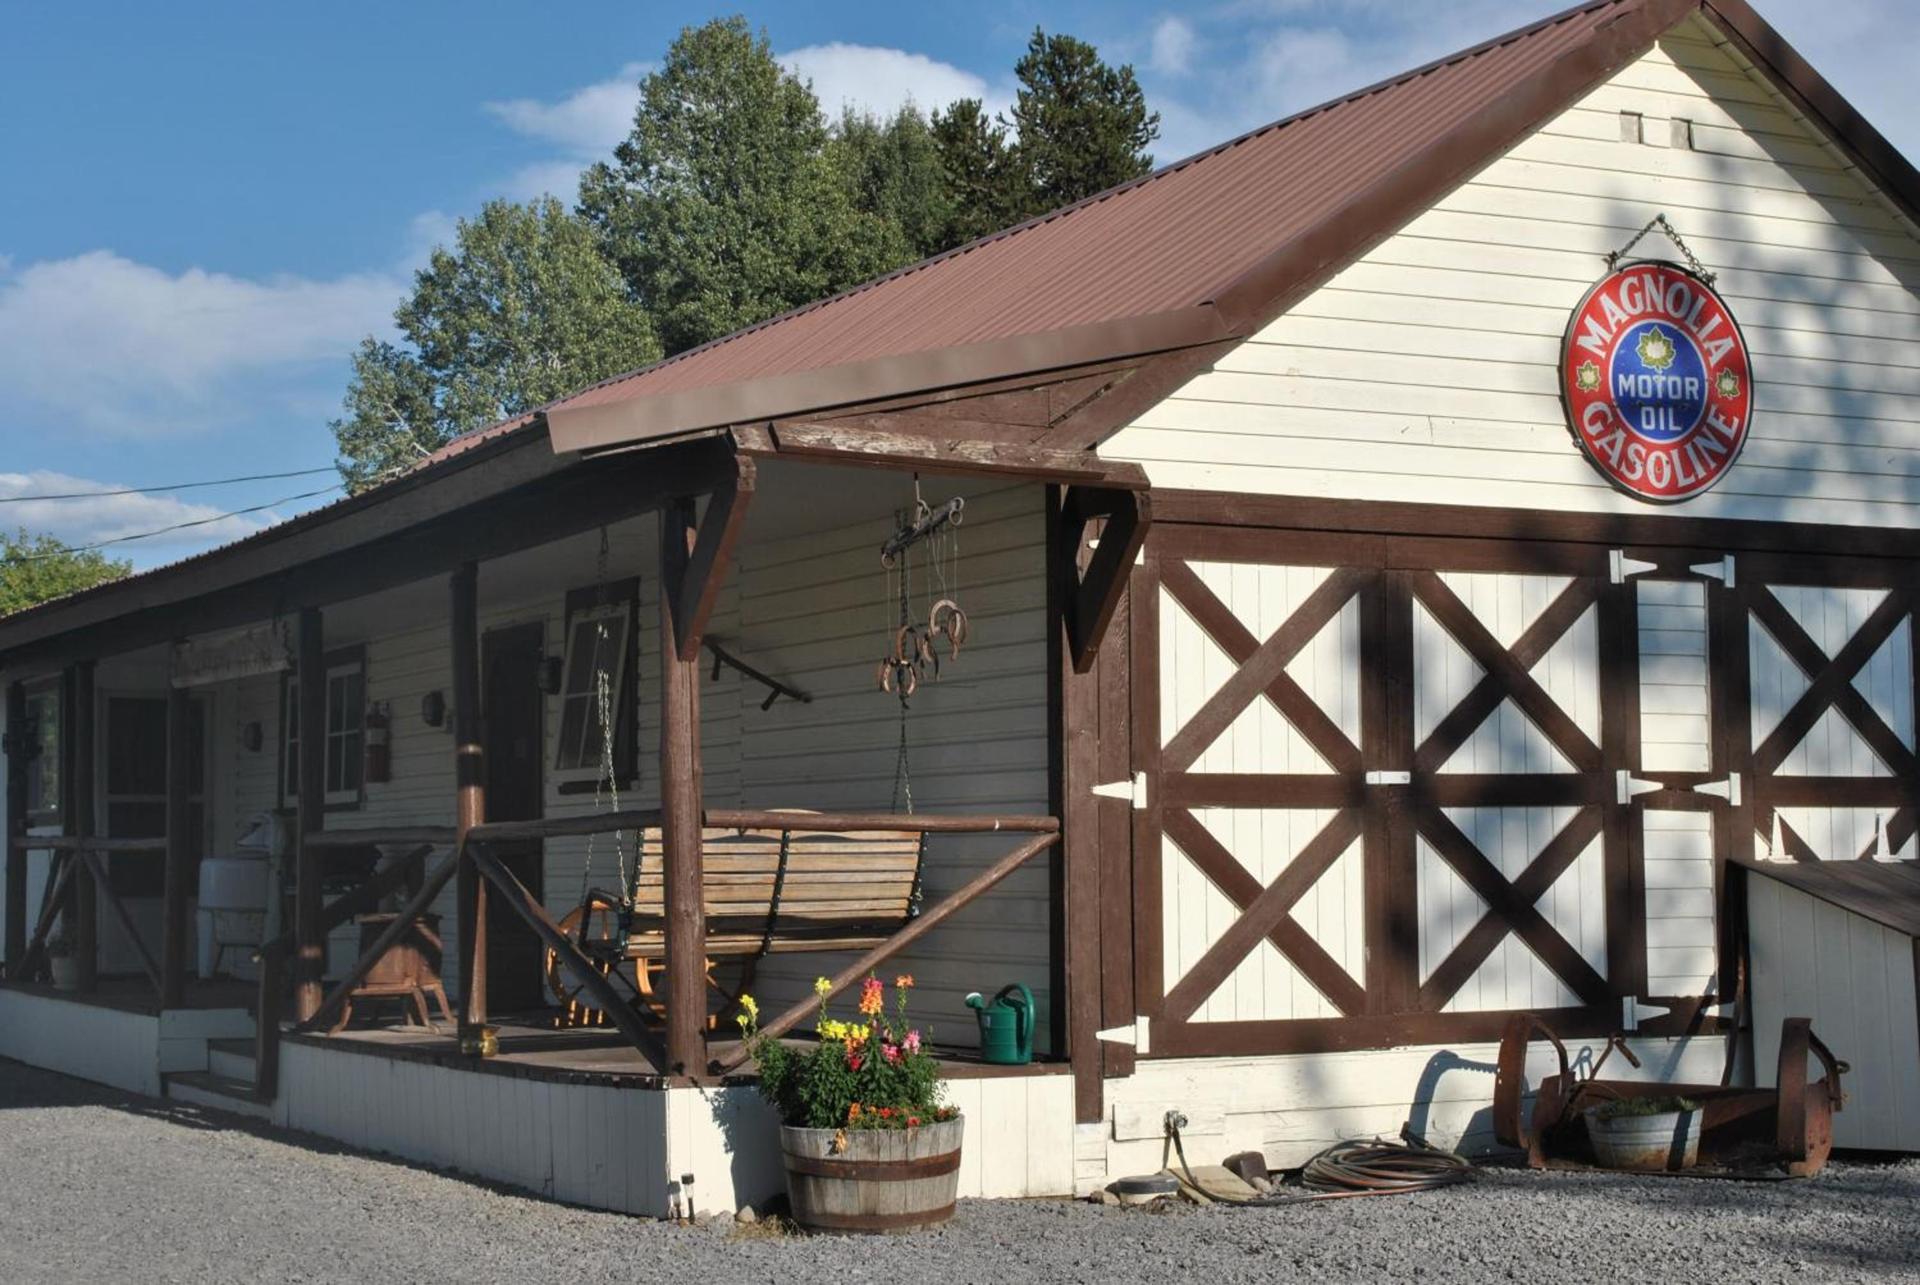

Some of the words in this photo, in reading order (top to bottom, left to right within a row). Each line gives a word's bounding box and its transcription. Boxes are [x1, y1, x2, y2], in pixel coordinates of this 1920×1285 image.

[1577, 273, 1735, 367] MAGNOLIA
[1618, 374, 1699, 400] MOTOR
[1583, 402, 1739, 488] GASOLINE
[1641, 406, 1682, 431] OIL
